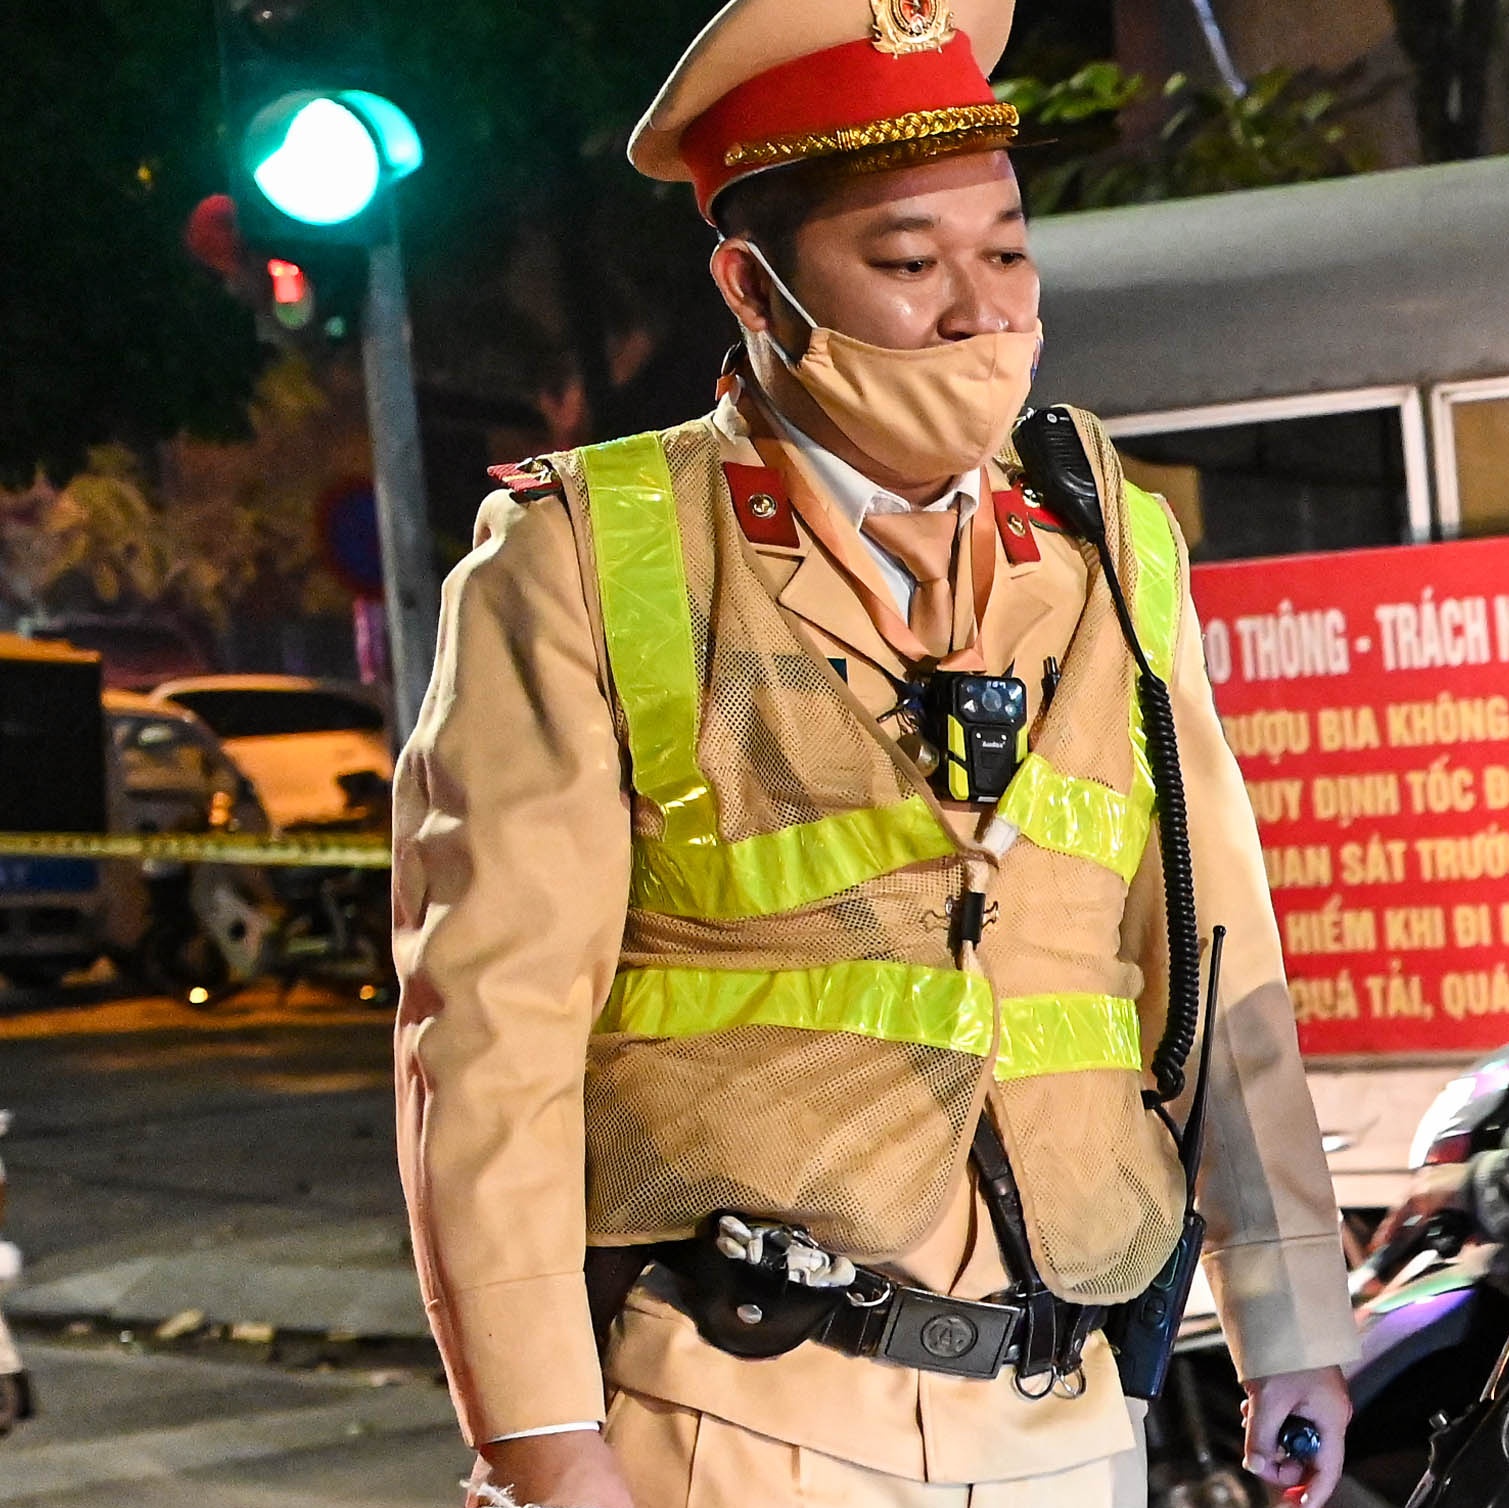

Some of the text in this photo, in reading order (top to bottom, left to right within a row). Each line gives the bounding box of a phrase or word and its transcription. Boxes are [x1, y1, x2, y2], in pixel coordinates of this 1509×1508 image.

[1234, 598, 1350, 683] THÔNG
[1374, 585, 1490, 671] TRÁCH
[1317, 704, 1381, 752] BIA
[1312, 772, 1400, 829] ĐỊNH
[1406, 754, 1477, 815] TỐC
[1339, 832, 1408, 886] SÁT
[1383, 907, 1446, 951] KHI
[1365, 957, 1434, 1022] TẢI,
